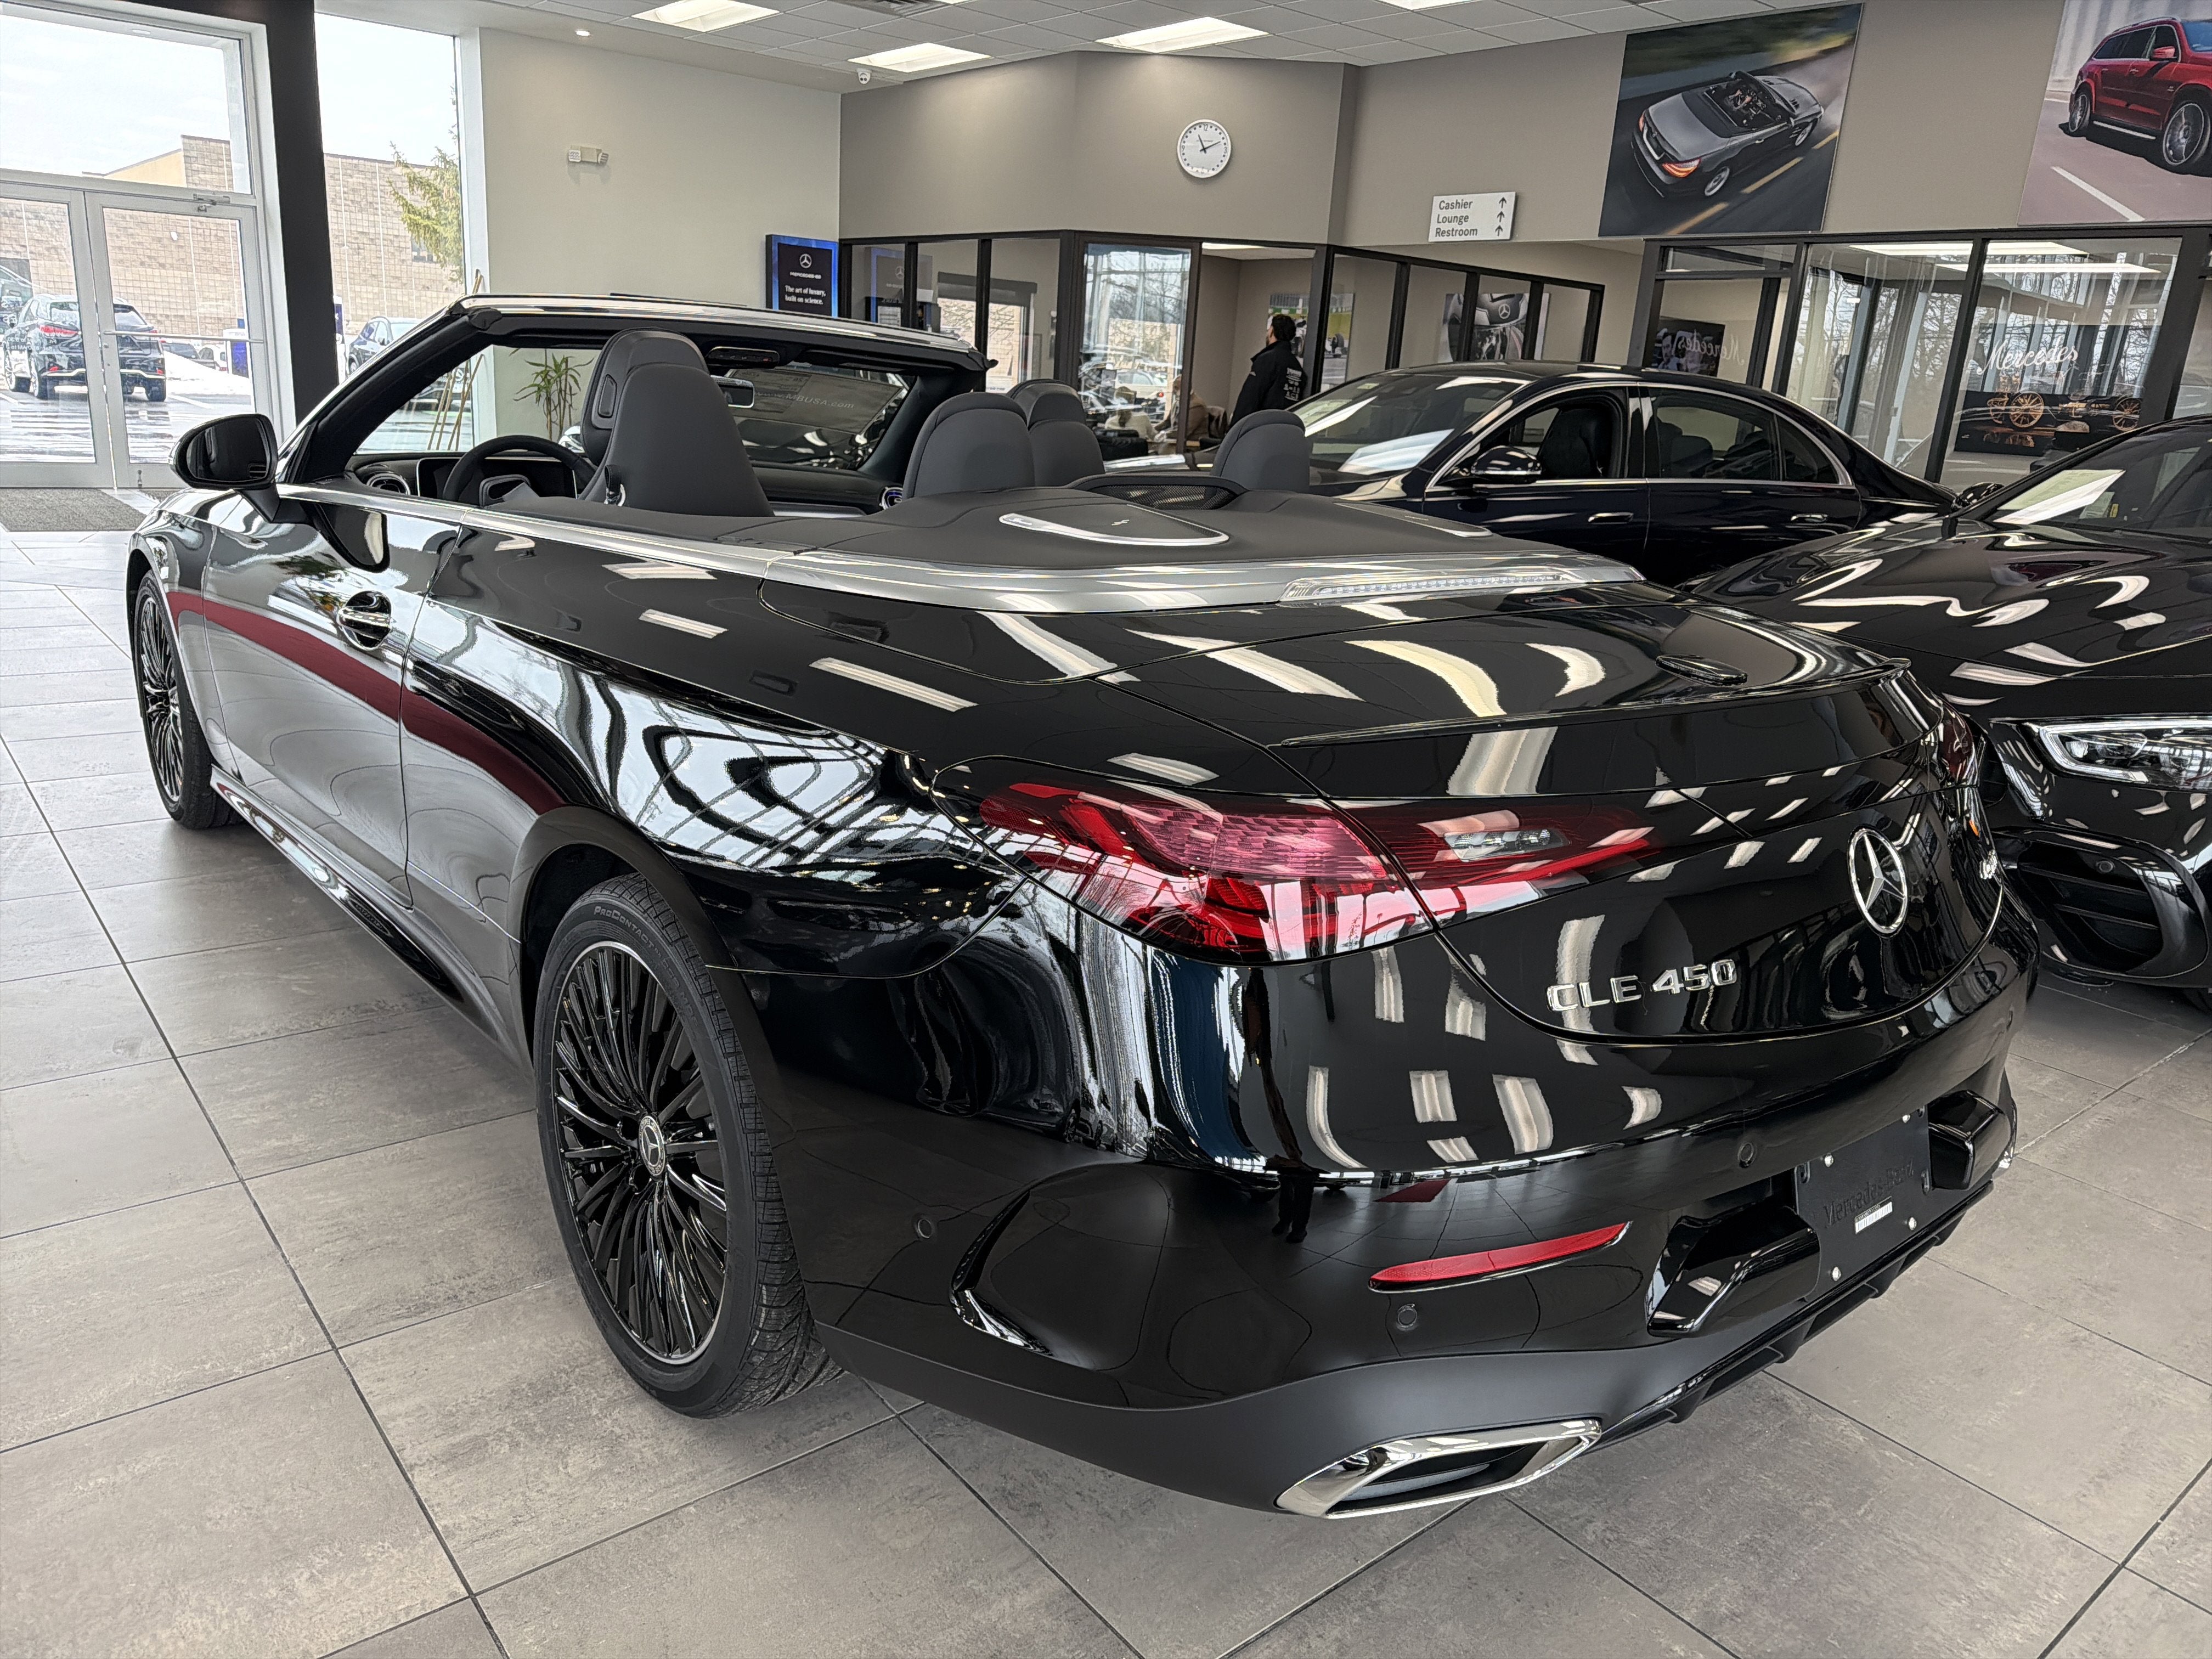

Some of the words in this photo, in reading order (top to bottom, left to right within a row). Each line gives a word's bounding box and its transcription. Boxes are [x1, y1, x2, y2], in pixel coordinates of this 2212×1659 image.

[1438, 199, 1473, 210] Cashier
[1437, 214, 1469, 225] Lounge
[1435, 227, 1478, 237] Restroom
[809, 288, 826, 297] luxury,
[1976, 335, 2078, 375] Mercedes
[1546, 975, 1643, 1012] CLE
[1650, 958, 1737, 995] 450
